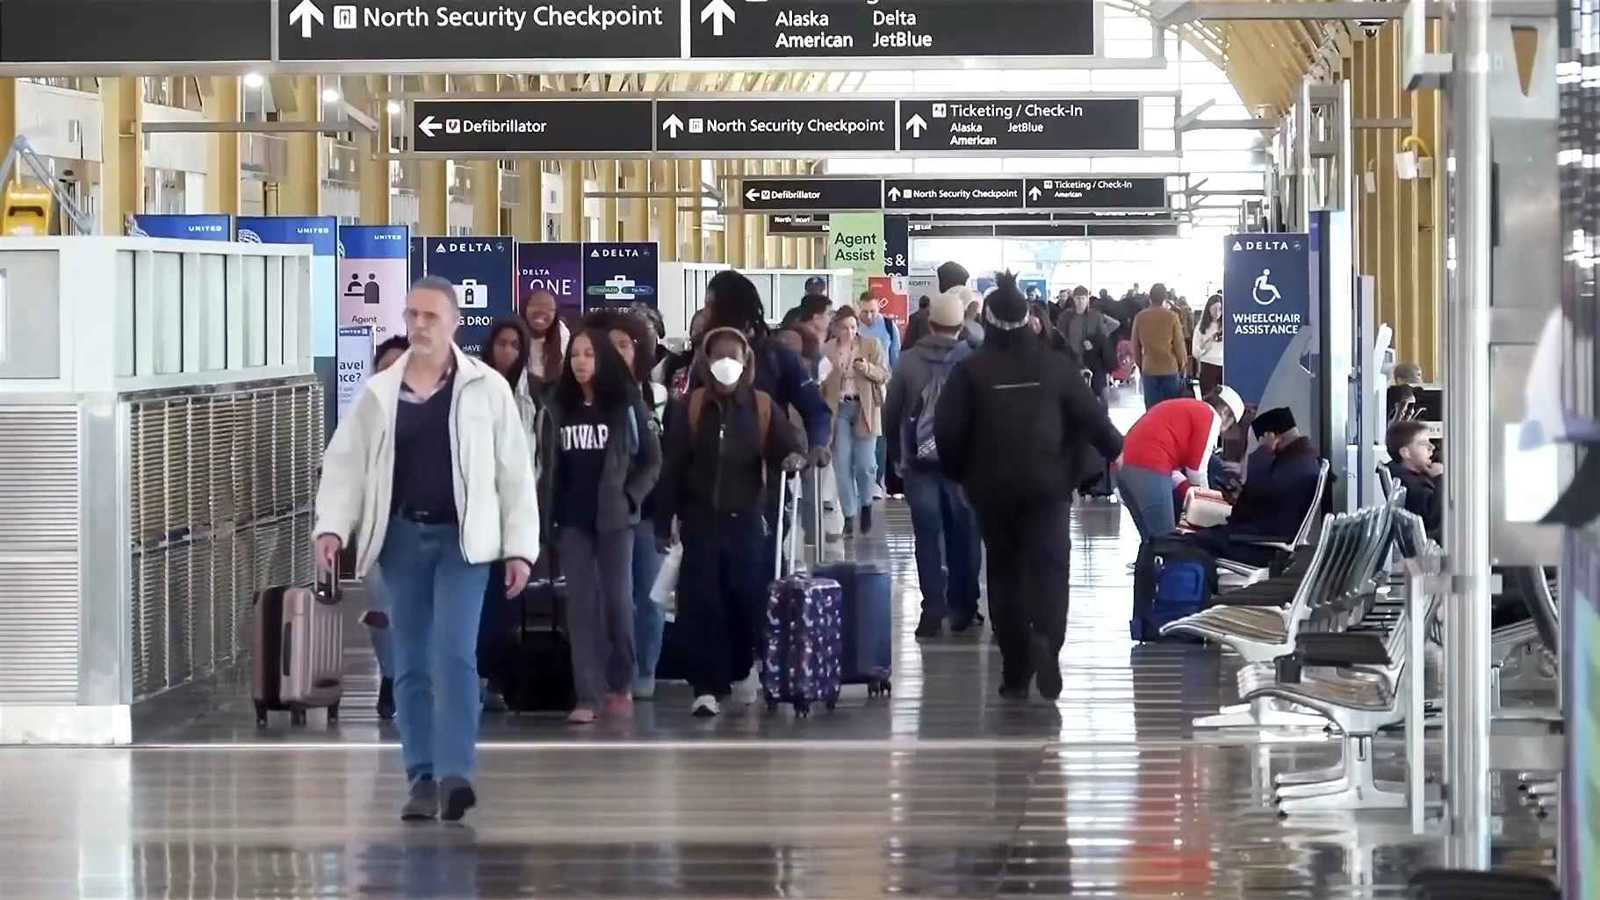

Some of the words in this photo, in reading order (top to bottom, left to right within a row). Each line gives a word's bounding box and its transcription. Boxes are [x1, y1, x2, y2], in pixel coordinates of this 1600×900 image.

[363, 5, 429, 27] North
[437, 5, 527, 31] Security
[533, 4, 663, 30] Checkpoint
[775, 10, 829, 27] Alaska
[873, 10, 917, 26] Delta
[775, 31, 854, 48] American
[872, 31, 933, 48] JetBlue
[950, 103, 1012, 120] Ticketing
[1015, 103, 1022, 118] /
[1024, 103, 1083, 117] Check-In
[463, 119, 548, 133] Defibrillator
[707, 118, 747, 132] North
[750, 118, 803, 135] Security
[807, 118, 885, 134] Checkpoint
[950, 122, 983, 133] Alaska
[1007, 122, 1044, 133] JetBlue
[950, 134, 997, 146] American
[1054, 180, 1091, 191] Ticketing
[1097, 180, 1133, 189] Check-In
[771, 190, 821, 200] Defibrillator
[913, 189, 938, 198] North
[939, 189, 971, 199] Security
[971, 189, 1018, 199] Checkpoint
[188, 224, 222, 232] UNITED
[834, 232, 878, 248] Agent
[449, 242, 492, 253] DELTA
[1246, 241, 1289, 251] DELTA
[602, 248, 639, 258] DELTA
[834, 247, 876, 262] Assist
[895, 253, 906, 267] &
[522, 268, 550, 276] DELTA
[530, 278, 572, 296] ONE
[351, 314, 377, 325] Agent
[1232, 313, 1301, 324] WHEELCHAIR
[1234, 324, 1299, 335] ASSISTANCE
[339, 359, 364, 370] avel
[339, 372, 362, 383] nce?
